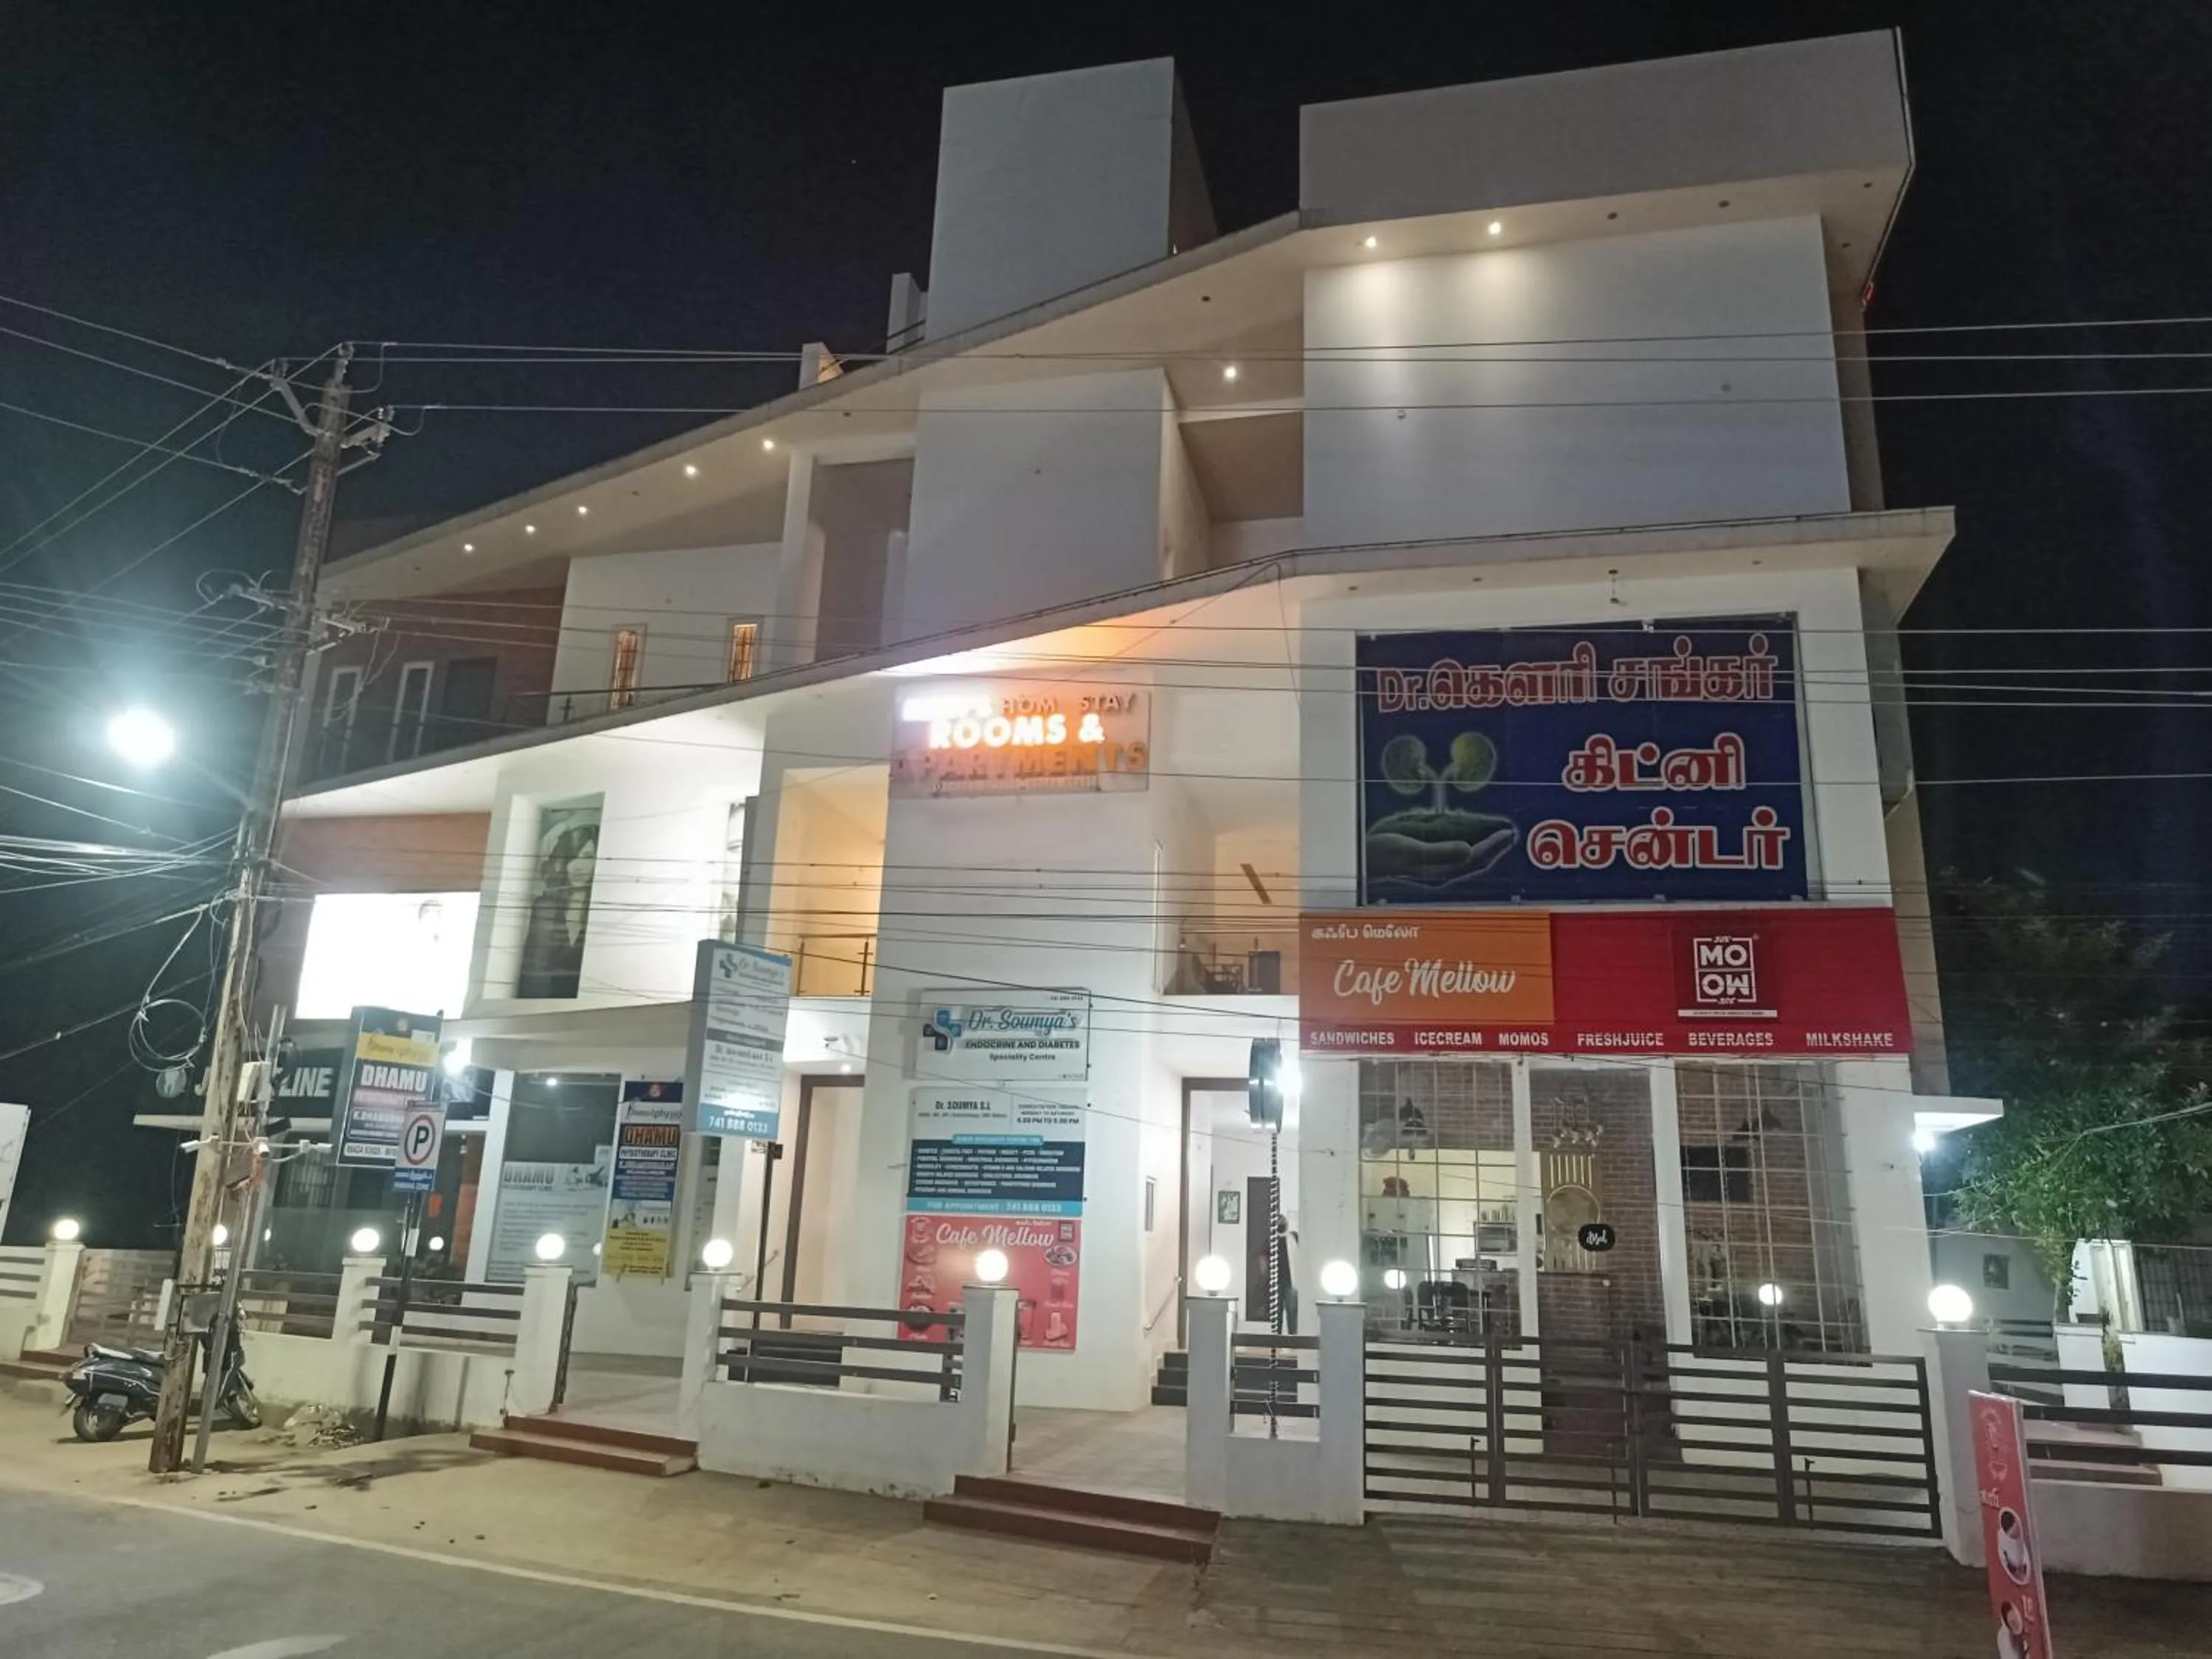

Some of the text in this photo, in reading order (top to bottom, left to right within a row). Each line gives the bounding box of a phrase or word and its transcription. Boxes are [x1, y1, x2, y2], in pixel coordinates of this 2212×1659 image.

[1079, 692, 1137, 714] STAY
[928, 712, 1105, 749] ROOMS &
[1562, 732, 1746, 790] கிட்னி
[1526, 806, 1791, 869] சென்டர்
[1333, 957, 1516, 1006] Cafe Mellow
[965, 1040, 1080, 1049] ENDOCRINE AND DIABETES
[1310, 1032, 1894, 1048] SANDWICHES ICECREAM MOMOS FRESHJUICE BEVERAGES MILKSHAKE
[361, 1065, 428, 1093] DHAMU
[413, 1125, 430, 1155] P
[936, 1222, 1054, 1250] Cafe Mellow
